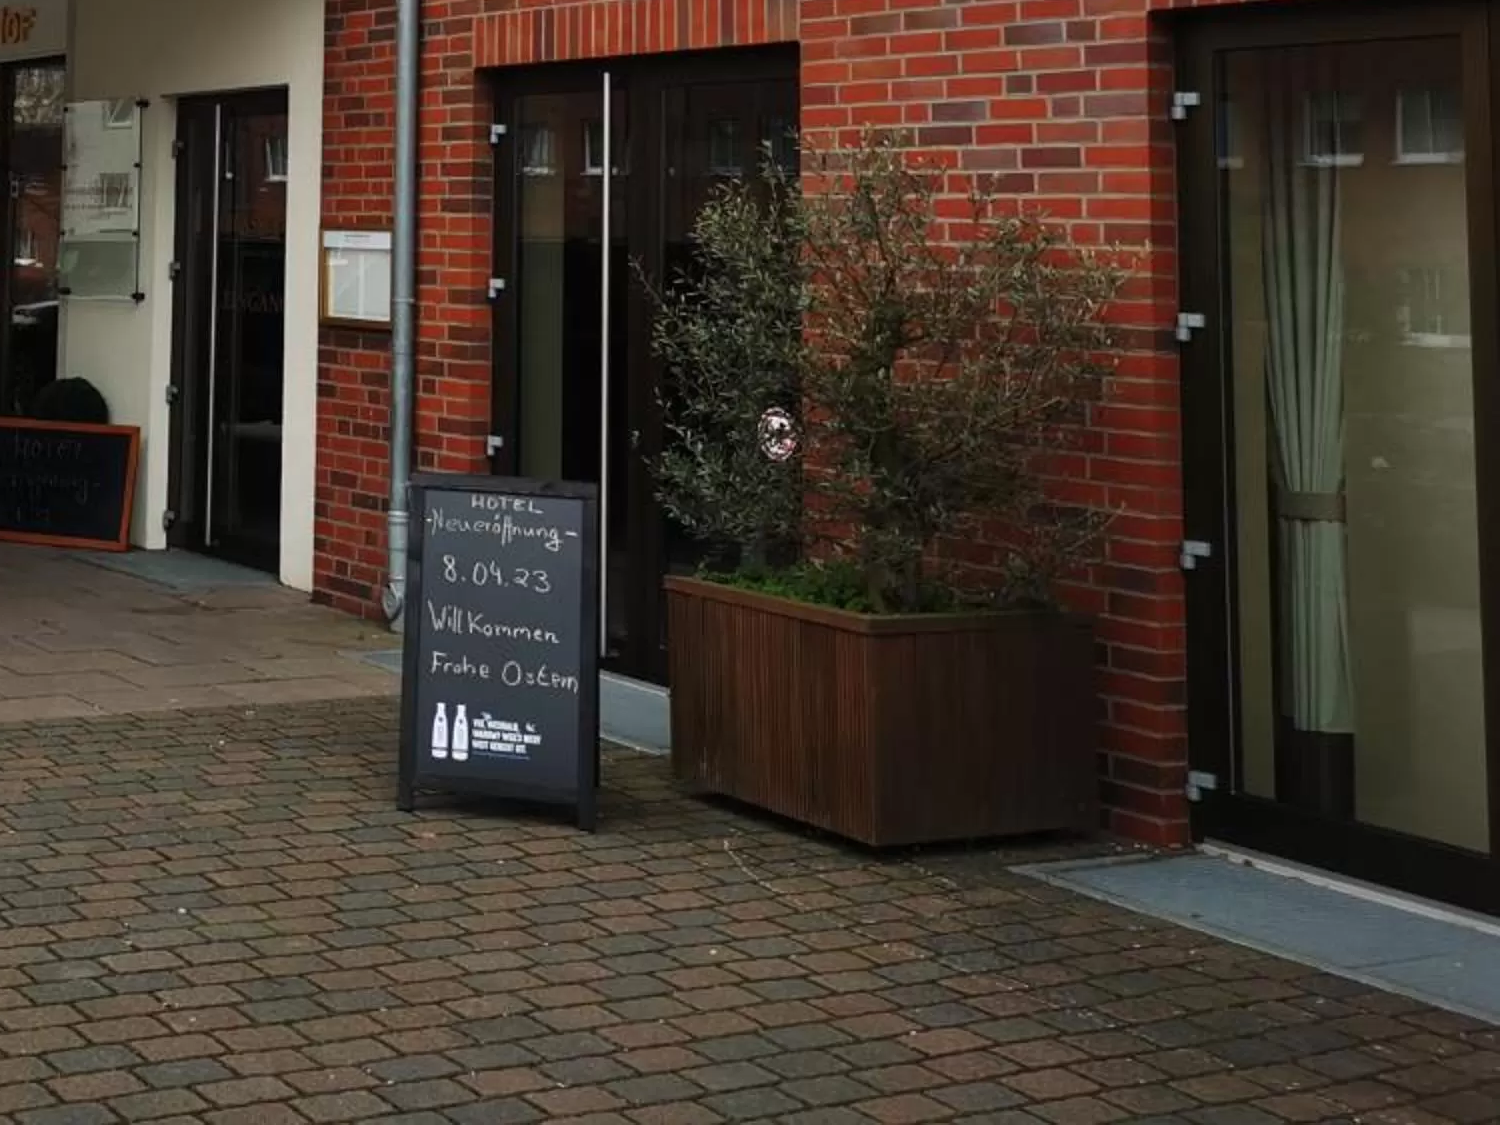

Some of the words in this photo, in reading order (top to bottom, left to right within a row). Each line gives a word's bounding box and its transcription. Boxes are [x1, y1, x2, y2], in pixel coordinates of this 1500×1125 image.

[471, 494, 544, 515] HOTEL
[431, 650, 490, 676] Frohe
[501, 660, 579, 695] Ostern
